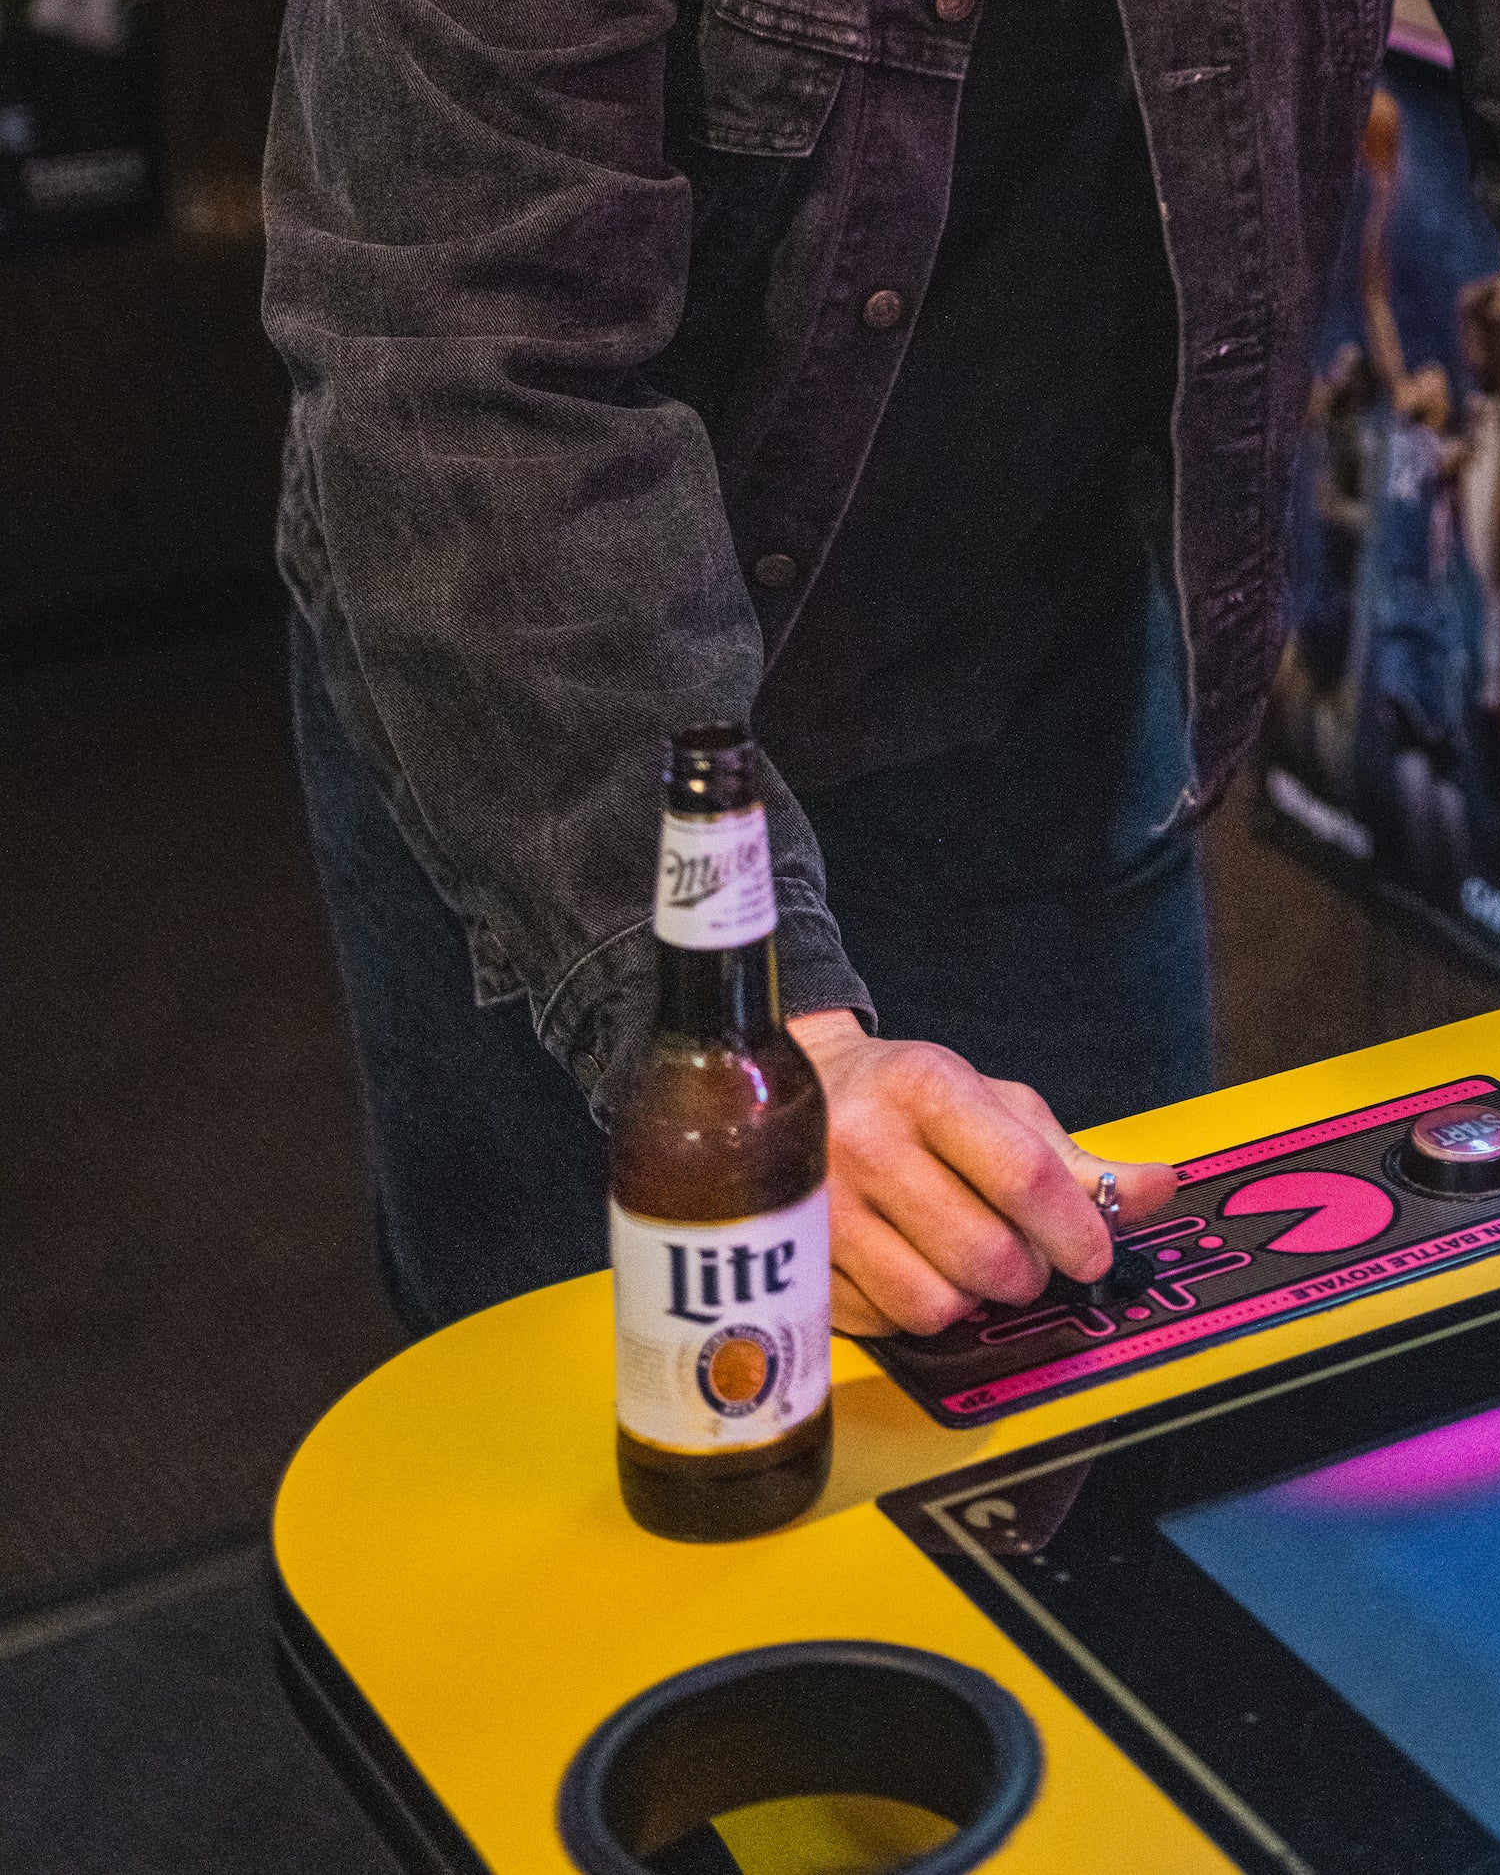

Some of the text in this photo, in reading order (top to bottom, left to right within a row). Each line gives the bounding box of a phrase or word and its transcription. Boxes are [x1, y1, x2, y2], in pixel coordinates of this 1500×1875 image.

[1388, 1233, 1475, 1268] BATTLE
[662, 1238, 797, 1325] Lite
[1292, 1262, 1387, 1300] ROYALE
